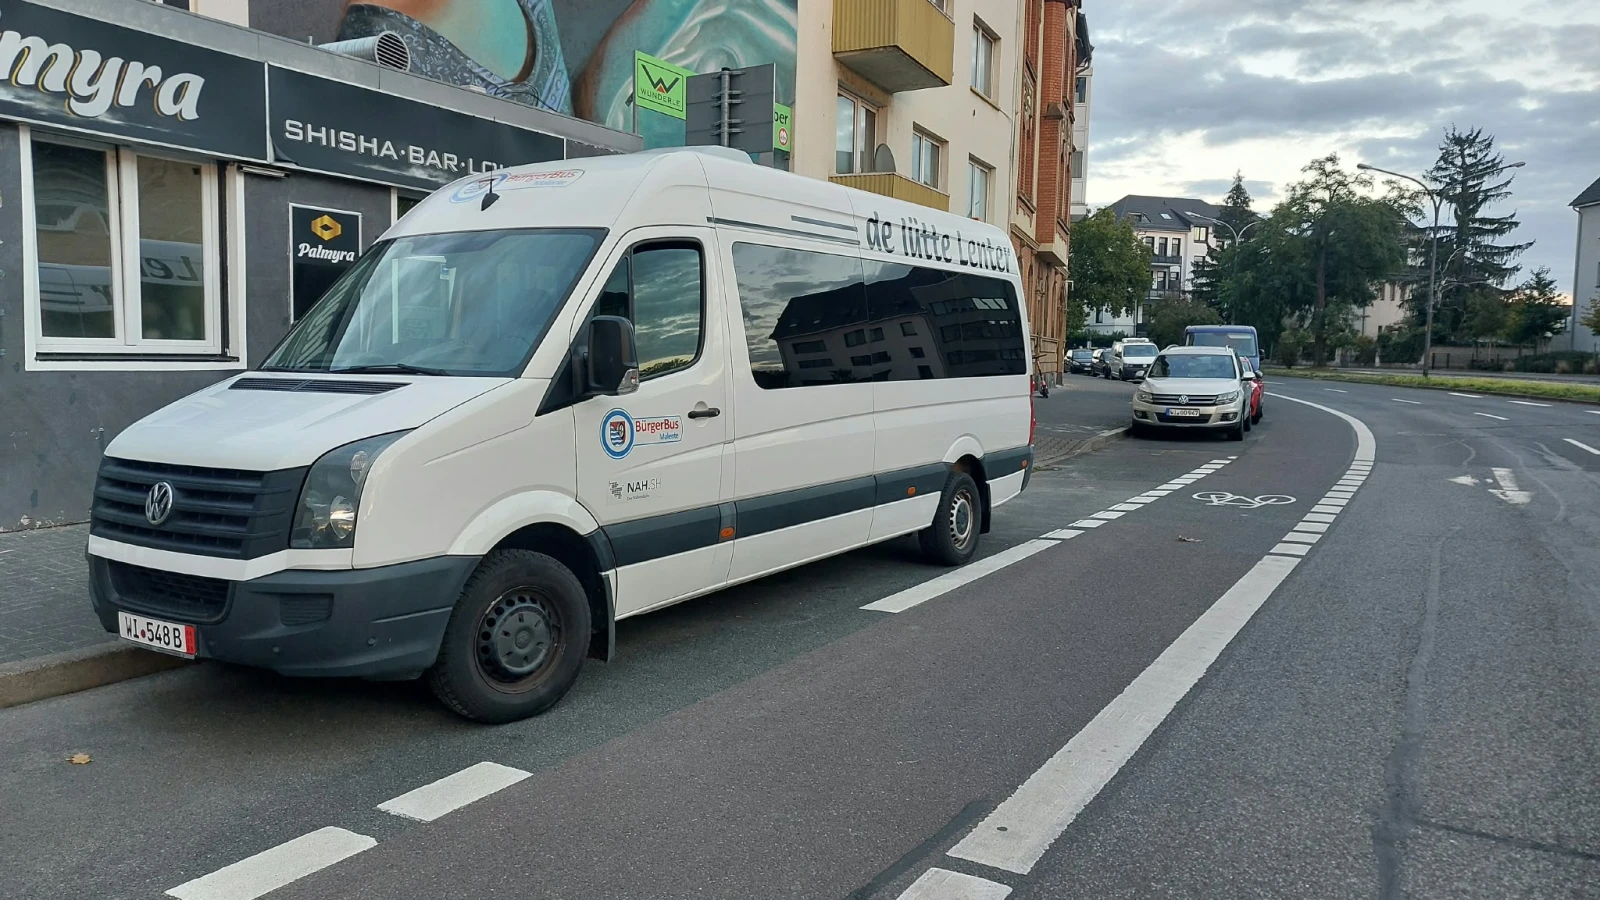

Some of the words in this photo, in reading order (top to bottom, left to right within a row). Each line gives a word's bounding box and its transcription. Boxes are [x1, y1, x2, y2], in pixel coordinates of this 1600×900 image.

[0, 30, 205, 121] myra
[640, 87, 681, 107] WUNDERLE
[866, 211, 895, 253] de
[900, 216, 952, 263] lütte
[298, 242, 355, 263] Palmyra
[635, 418, 679, 434] BürgerBus
[659, 432, 679, 440] Malente
[627, 478, 662, 493] NAH.SH
[125, 616, 139, 639] WI
[146, 621, 171, 646] 548
[173, 627, 182, 648] B
